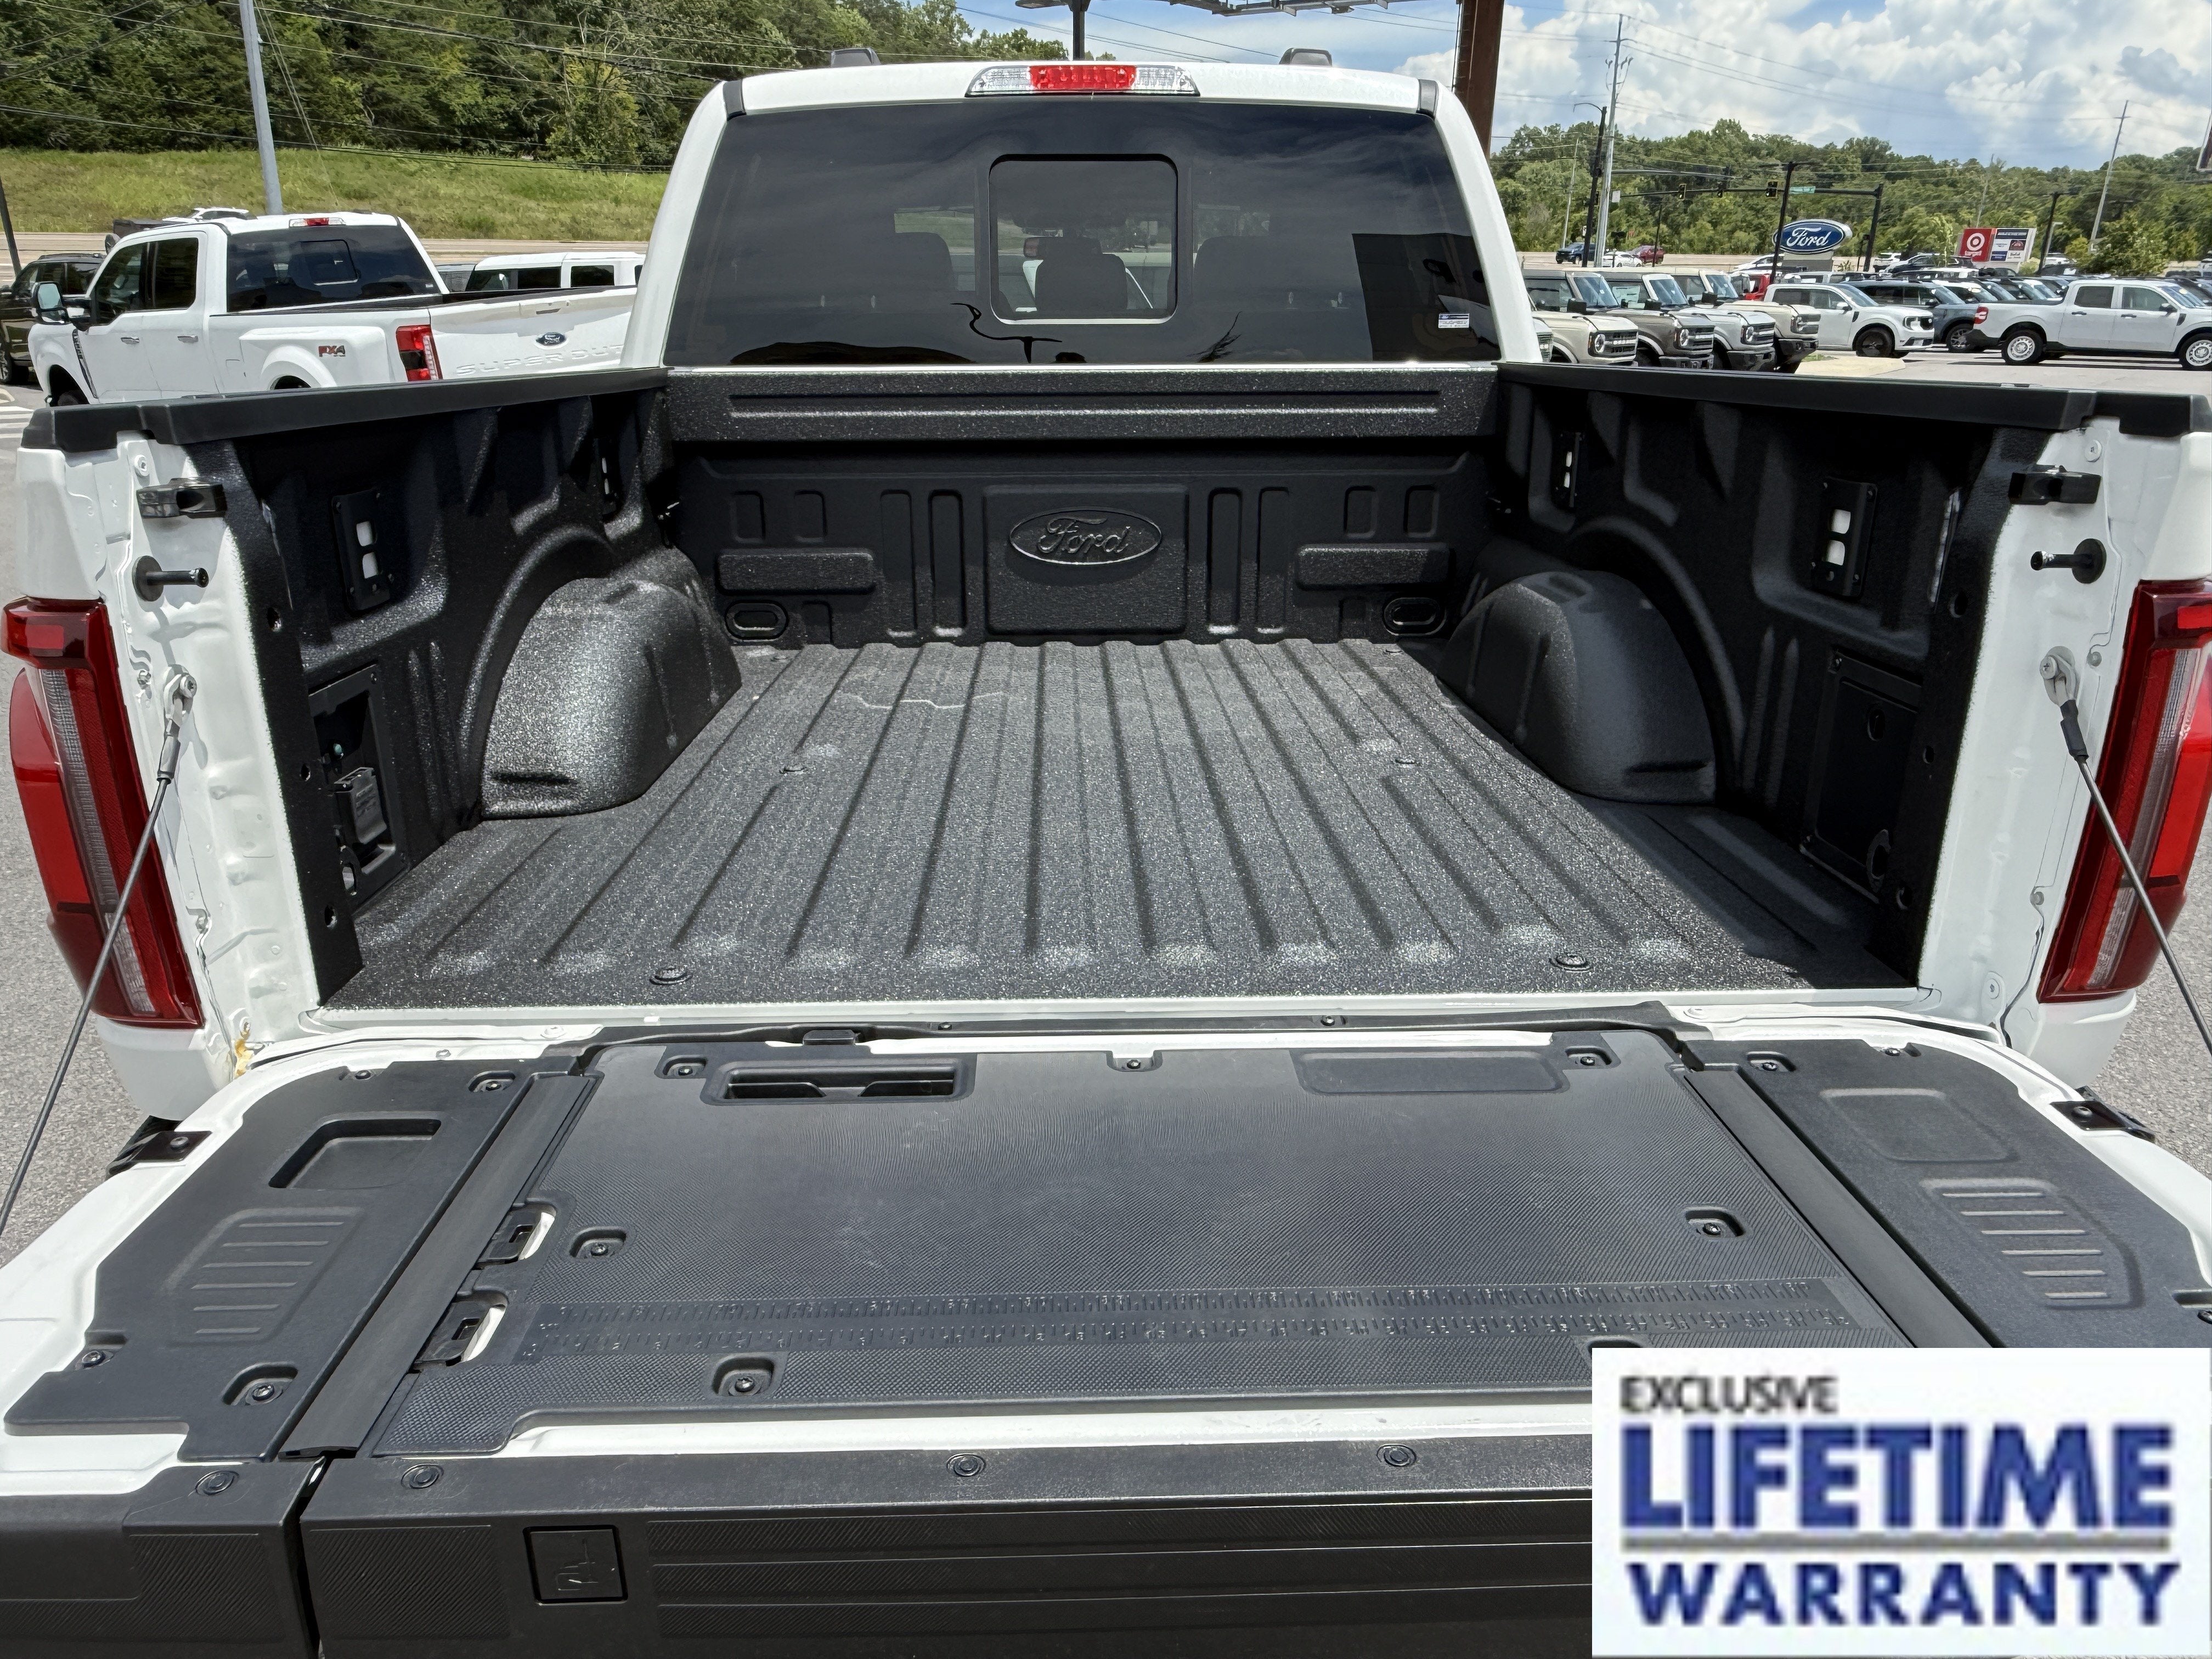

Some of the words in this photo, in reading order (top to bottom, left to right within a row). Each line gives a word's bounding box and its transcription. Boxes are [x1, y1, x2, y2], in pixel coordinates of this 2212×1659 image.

[1786, 227, 1832, 247] Ford
[318, 345, 346, 357] FX4
[456, 353, 565, 376] SUPER
[571, 344, 624, 360] DUT
[1037, 517, 1131, 554] Ford
